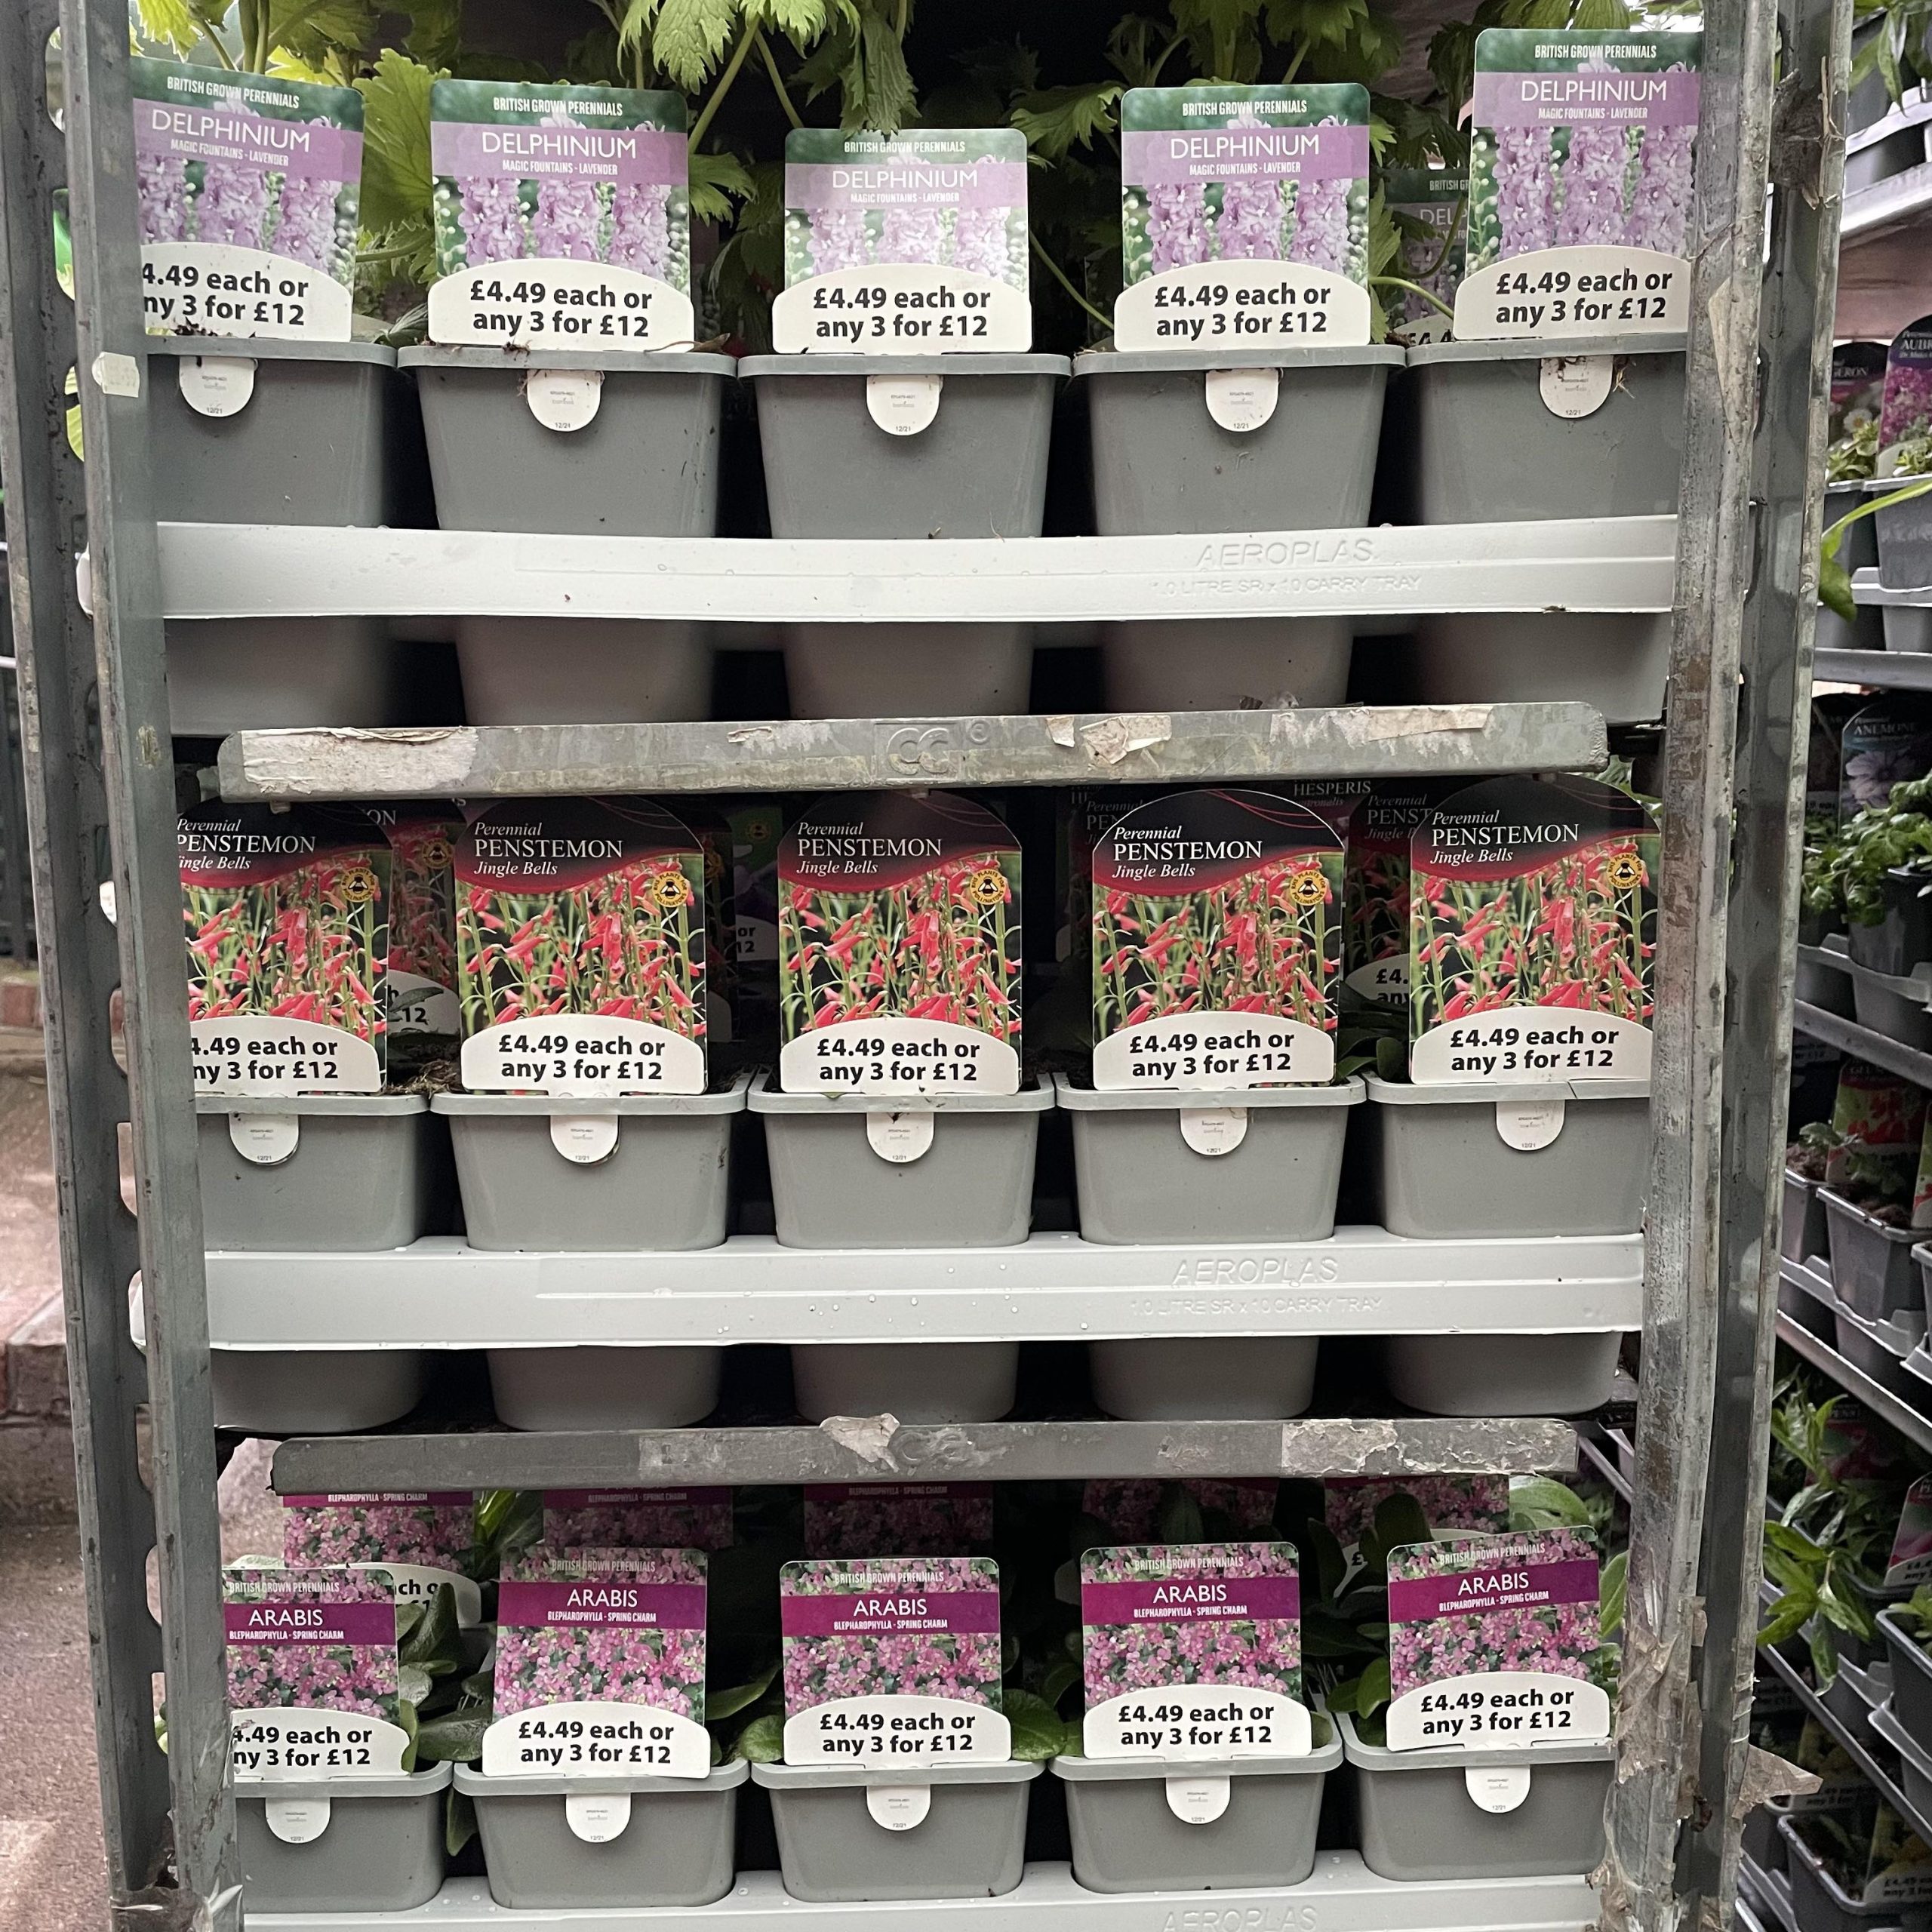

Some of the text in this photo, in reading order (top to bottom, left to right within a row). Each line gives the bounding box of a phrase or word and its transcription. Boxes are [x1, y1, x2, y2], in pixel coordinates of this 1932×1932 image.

[1534, 45, 1657, 58] BRITISH GROWN PERENNIALS
[168, 76, 300, 109] BRITISH GROWN PERENNIALS
[1521, 80, 1667, 101] DELPHINIUM
[494, 97, 623, 116] BRITISH GROWN PERENNIALS
[1183, 100, 1307, 116] BRITISH GROWN PERENNIALS
[1538, 108, 1563, 119] MAGIC
[1564, 108, 1605, 119] FOUNTAINS
[1611, 107, 1647, 118] LAVENDER
[152, 109, 309, 152] DELPHINIUM
[482, 131, 636, 159] DELPHINIUM
[844, 141, 965, 152] BRITISH GROWN PERENNIALS
[1171, 134, 1319, 159] DELPHINIUM
[503, 160, 528, 171] MAGIC
[530, 161, 573, 174] FOUNTAINS
[579, 164, 617, 175] LAVENDER
[1189, 164, 1215, 176] MAGIC
[1217, 163, 1258, 175] FOUNTAINS
[1263, 162, 1301, 174] LAVENDER
[832, 170, 977, 189] DELPHINIUM
[851, 193, 875, 203] MAGIC
[877, 193, 918, 203] FOUNTAINS
[923, 192, 959, 202] LAVENDER
[142, 263, 309, 297] 4.49 each or
[1496, 268, 1672, 294] £4.49 each or
[470, 280, 652, 309] £4.49 each or
[814, 285, 991, 309] £4.49 each or
[1155, 282, 1331, 307] £4.49 each or
[144, 295, 304, 325] ny 3 for £12
[817, 314, 987, 343] any 3 for £12
[1196, 539, 1374, 567] AEROPLAS
[1294, 780, 1371, 796] HESPERIS
[1367, 793, 1427, 807] Perennial
[177, 819, 241, 832] Perennial
[1432, 810, 1500, 826] Perennial
[474, 822, 542, 836] Perennial
[797, 822, 864, 835] Perennial
[1114, 825, 1182, 841] Perennial
[1432, 823, 1580, 847] PENSTEMON
[474, 839, 623, 858] PENSTEMON
[798, 838, 942, 857] PENSTEMON
[1113, 841, 1263, 861] PENSTEMON
[1430, 848, 1513, 866] Jingle Bells
[179, 856, 251, 872] ingle Bells
[473, 861, 558, 878] Jingle Bells
[796, 860, 878, 877] Jingle Bells
[1111, 863, 1195, 881] Jingle Bells
[190, 1036, 338, 1055] 4.49 each or
[499, 1035, 665, 1057] £4.49 each or
[1130, 1029, 1294, 1054] £4.49 each or
[1450, 1026, 1620, 1048] £4.49 each or
[817, 1038, 980, 1058] £4.49 each or
[820, 1061, 977, 1085] any 3 for £12
[1172, 1257, 1339, 1285] AEROPLAS
[328, 1494, 379, 1503] BLEPHAROPHYLLA
[383, 1494, 405, 1502] SPRING
[406, 1494, 428, 1502] CHARM
[835, 1571, 944, 1584] BRITISH GROWN PERENNIALS
[1458, 1572, 1529, 1596] ARABIS
[567, 1589, 638, 1607] ARABIS
[1153, 1584, 1227, 1604] ARABIS
[1439, 1598, 1495, 1613] BLEPHAROPHYLLA
[1500, 1593, 1524, 1604] SPRING
[1524, 1590, 1549, 1601] CHARM
[547, 1611, 603, 1622] BLEPHAROPHYLLA
[608, 1612, 632, 1622] SPRING
[632, 1612, 656, 1623] CHARM
[853, 1598, 928, 1617] ARABIS
[248, 1609, 324, 1626] ARABIS
[1420, 1689, 1574, 1713] £4.49 each or
[820, 1712, 976, 1730] £4.49 each or
[1118, 1703, 1274, 1723] £4.49 each or
[232, 1726, 372, 1744] 4.49 each or
[518, 1721, 674, 1740] £4.49 each or
[823, 1734, 973, 1757] any 3 for £12
